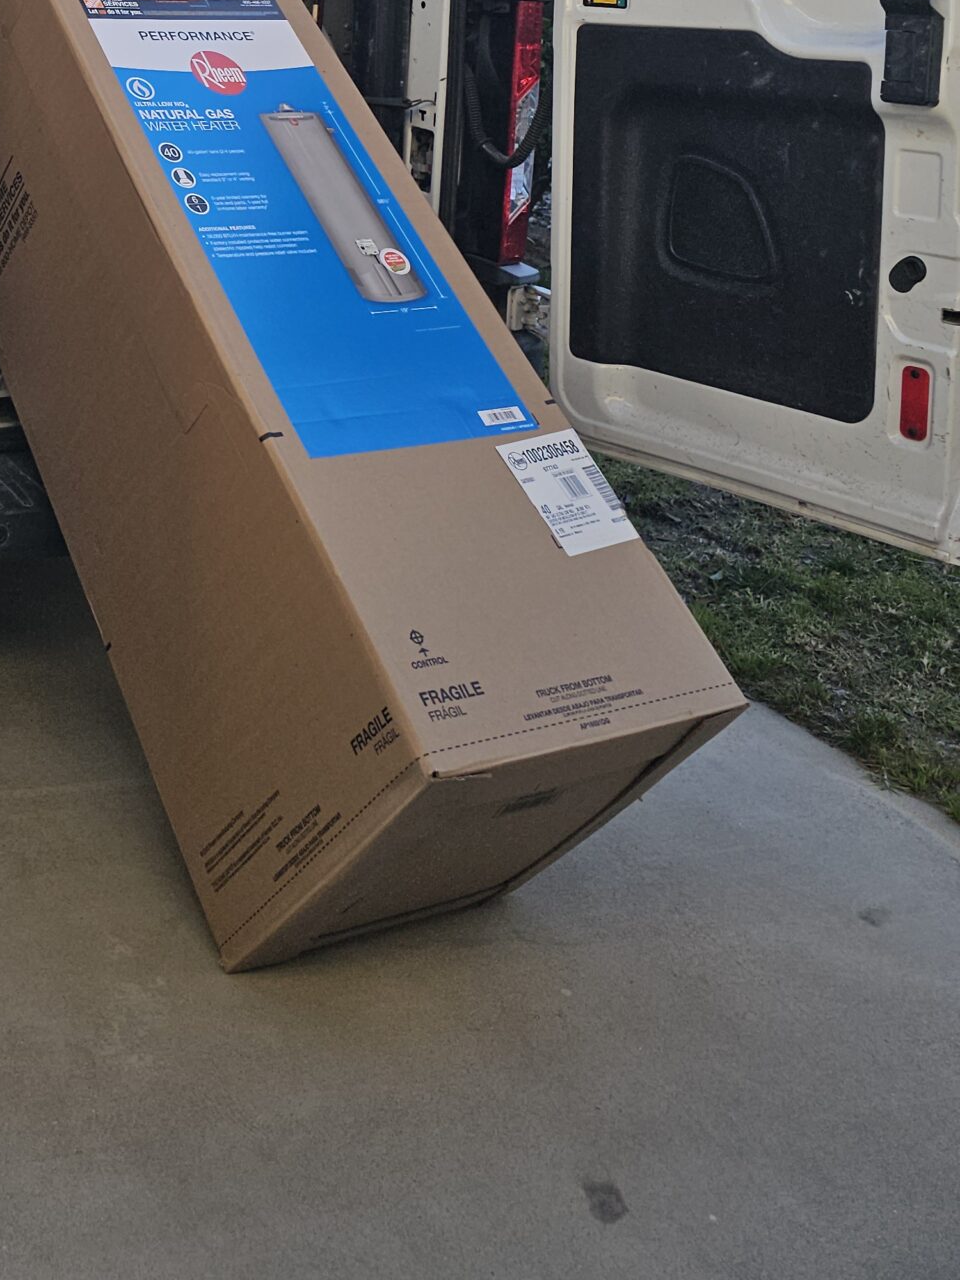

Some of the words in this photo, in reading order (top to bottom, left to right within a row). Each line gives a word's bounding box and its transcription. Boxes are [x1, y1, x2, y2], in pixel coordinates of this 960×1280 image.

[138, 31, 254, 41] PERFORMANCE
[192, 51, 246, 89] Rheem
[138, 109, 204, 120] NATURAL
[205, 109, 235, 119] GAS
[144, 121, 190, 132] WATER
[191, 120, 241, 131] HEATER
[164, 148, 179, 158] 40
[191, 196, 199, 204] 6
[2, 229, 10, 242] do
[11, 209, 20, 224] for
[522, 439, 580, 465] 1002306458
[541, 504, 552, 515] 40
[411, 656, 449, 670] CONTROL
[419, 681, 485, 706] FRAGILE
[535, 687, 561, 699] TRUCK
[560, 681, 583, 693] FROM
[581, 674, 613, 689] BOTTOM
[428, 704, 467, 722] FRÁGIL
[350, 706, 393, 756] FRAGILE
